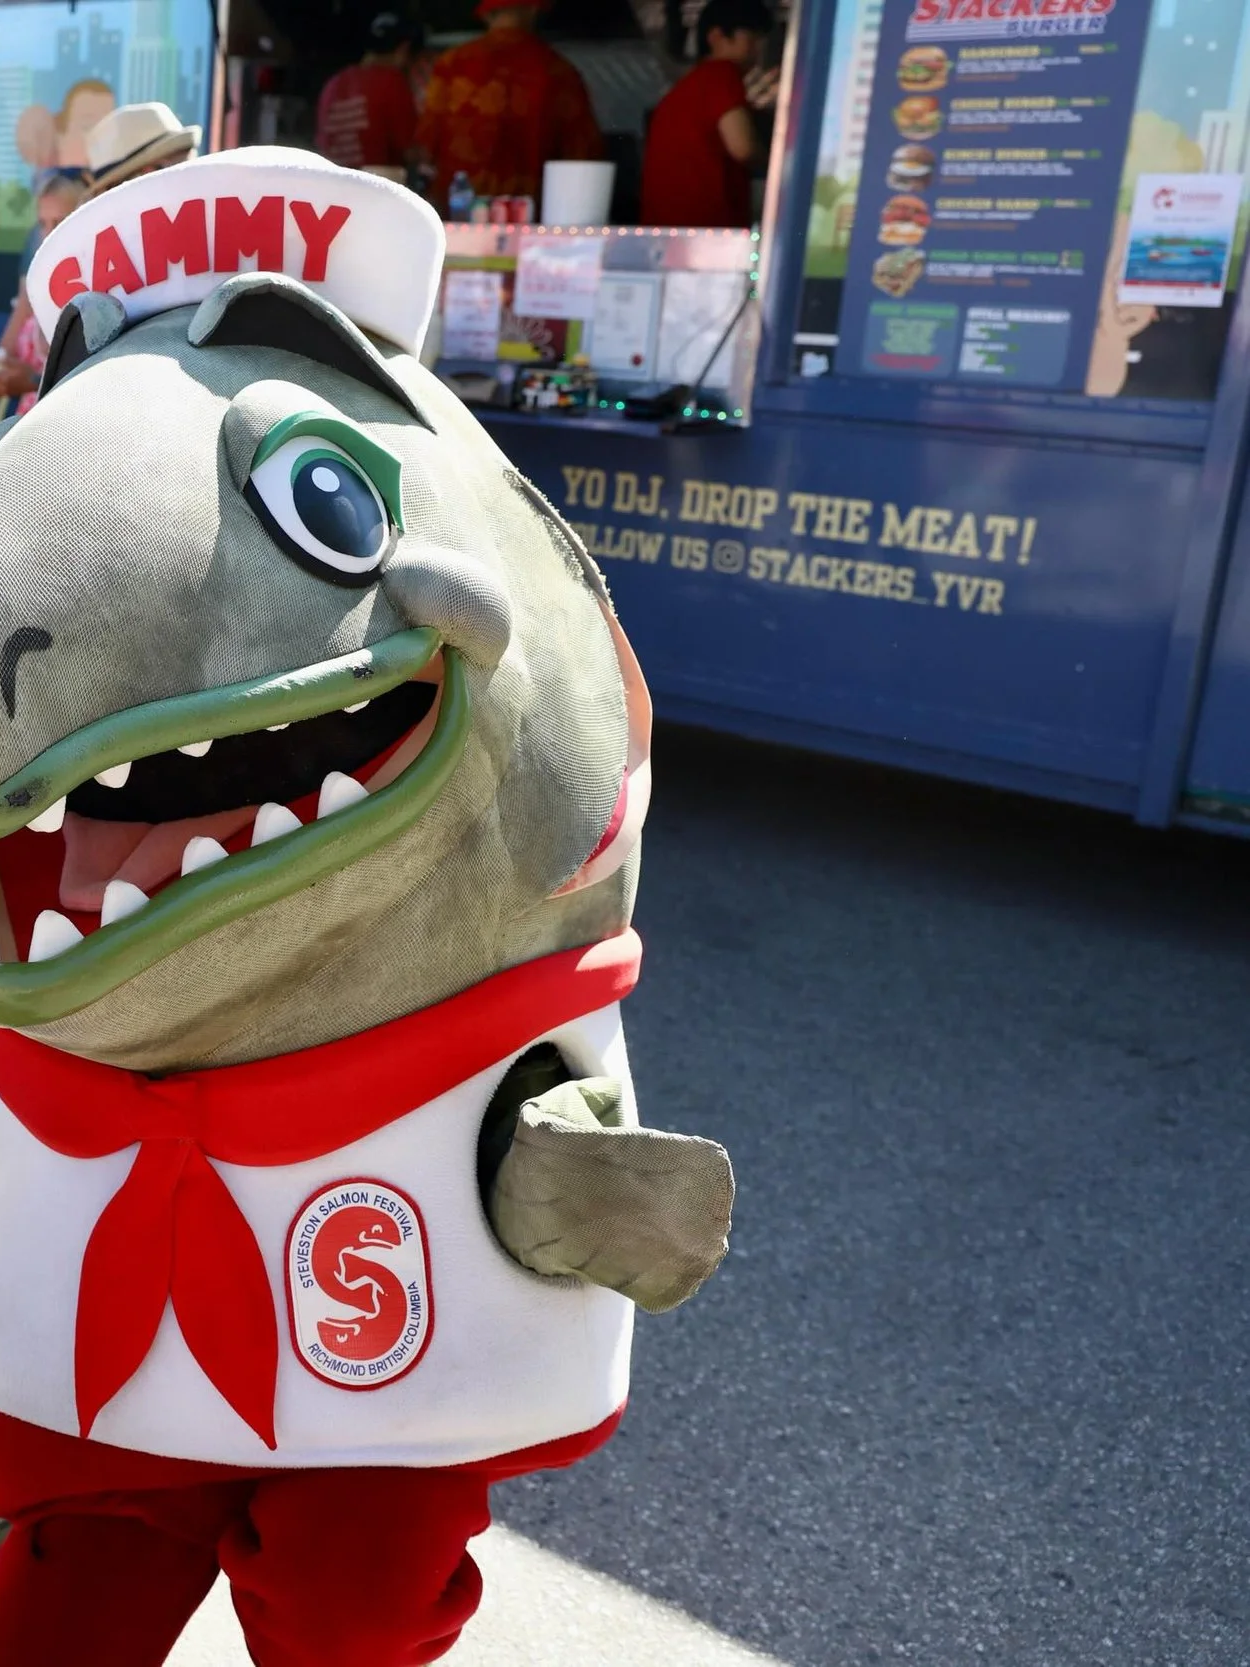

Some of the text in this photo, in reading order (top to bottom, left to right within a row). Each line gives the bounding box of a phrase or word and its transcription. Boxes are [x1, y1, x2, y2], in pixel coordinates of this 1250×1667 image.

[49, 195, 352, 309] SAMMY
[562, 466, 606, 509] YO
[679, 479, 778, 530] DROP
[788, 492, 873, 544] THE
[878, 502, 1037, 565] MEAT!
[671, 535, 709, 570] US
[296, 1191, 414, 1289] STEVESTON SALMON FESTIVAL
[308, 1281, 422, 1376] RICHMOND BRITISH COLUMBIA
